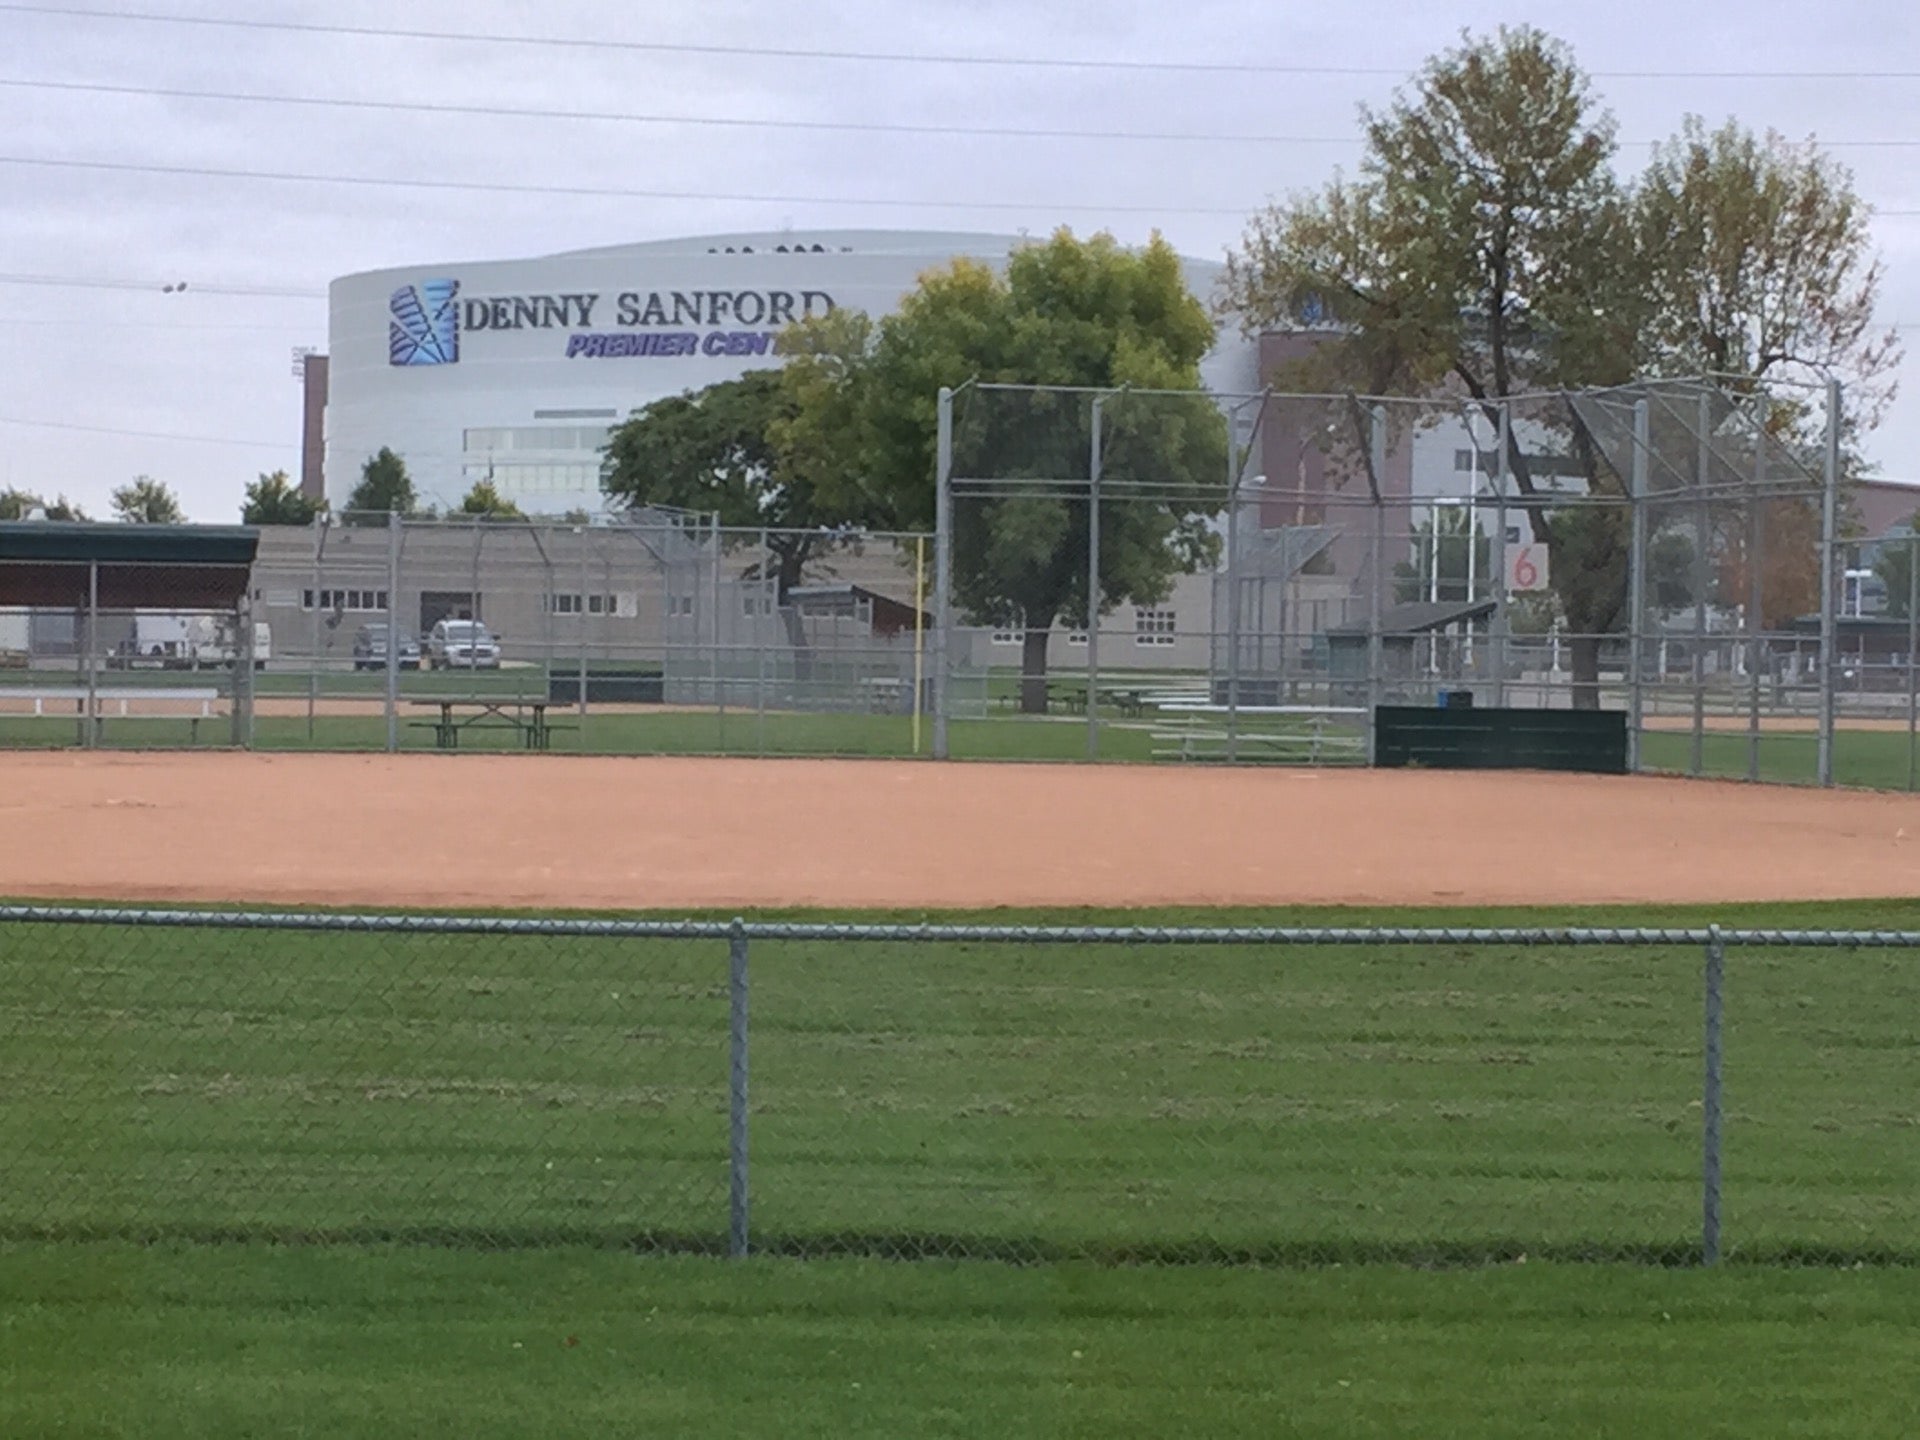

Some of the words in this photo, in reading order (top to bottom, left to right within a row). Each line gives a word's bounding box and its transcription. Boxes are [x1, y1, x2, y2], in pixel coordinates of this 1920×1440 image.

[463, 294, 599, 331] DENNY
[617, 291, 836, 326] SANFORD
[566, 333, 699, 358] PREMIER
[702, 331, 806, 356] CEN
[1514, 547, 1537, 587] 6
